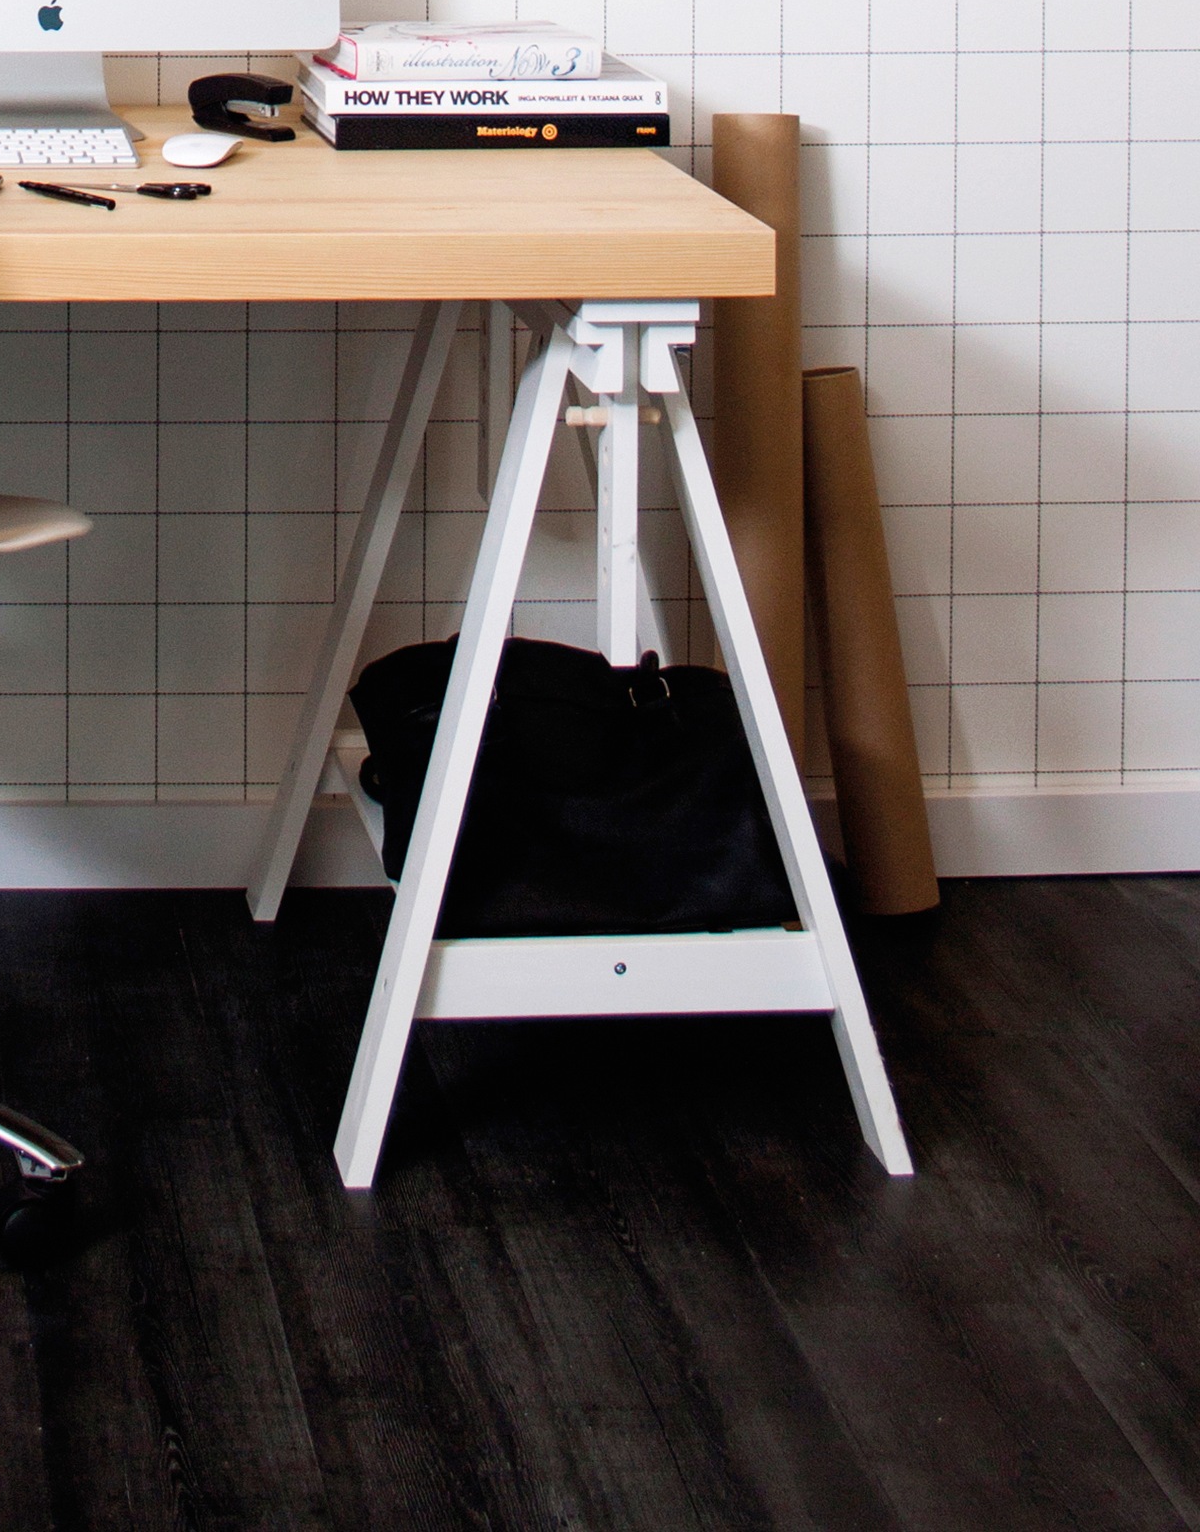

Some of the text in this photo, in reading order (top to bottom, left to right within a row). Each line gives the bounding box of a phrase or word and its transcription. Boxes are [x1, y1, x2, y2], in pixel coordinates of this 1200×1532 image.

[551, 47, 582, 77] 3
[344, 90, 510, 106] HOW THEY WORK
